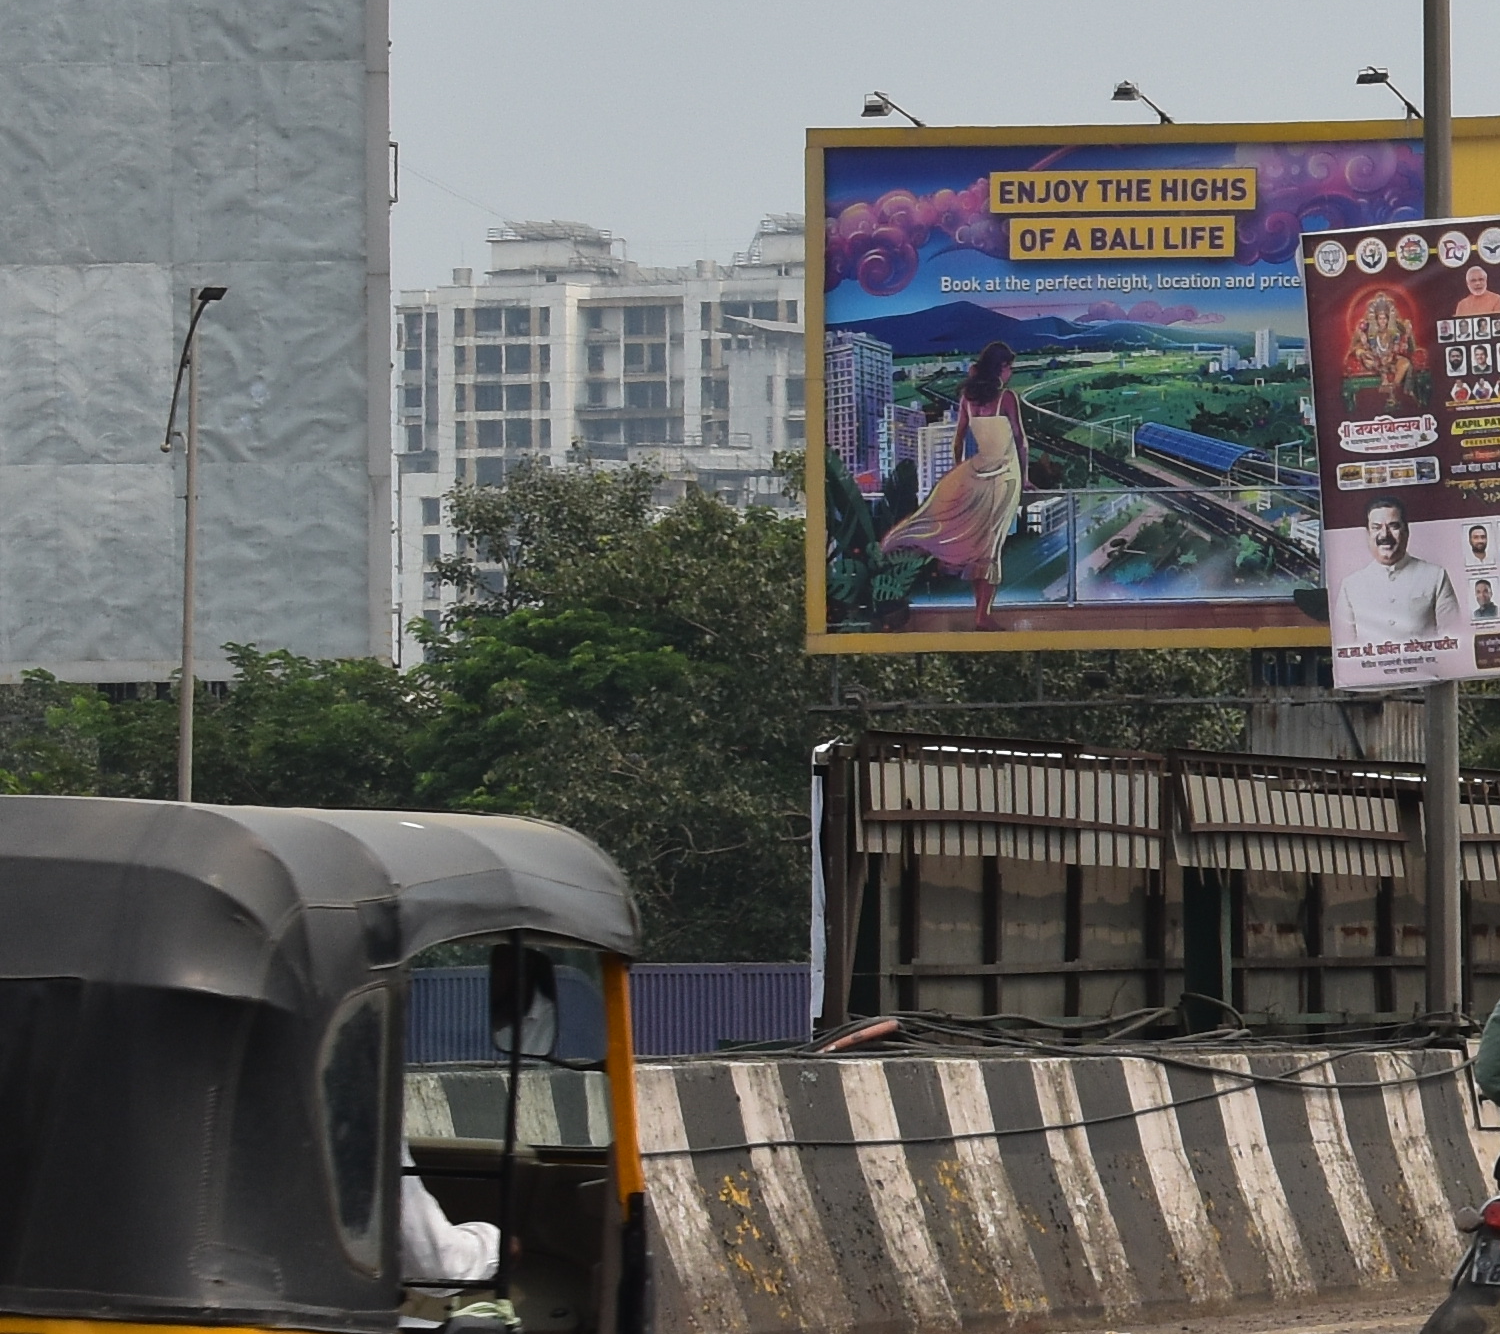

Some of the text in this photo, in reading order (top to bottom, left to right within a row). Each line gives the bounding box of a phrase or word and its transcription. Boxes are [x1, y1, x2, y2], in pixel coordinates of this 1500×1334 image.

[1000, 177, 1247, 204] ENJOY THE HIGHS
[1019, 226, 1225, 252] OF A BALI LIFE
[940, 276, 979, 292] Book
[985, 277, 1002, 291] at
[1005, 276, 1030, 291] the
[1035, 274, 1092, 294] perfect
[1097, 273, 1153, 292] height,
[1157, 273, 1220, 289] location
[1225, 272, 1255, 288] and
[1456, 419, 1482, 429] KAPIL
